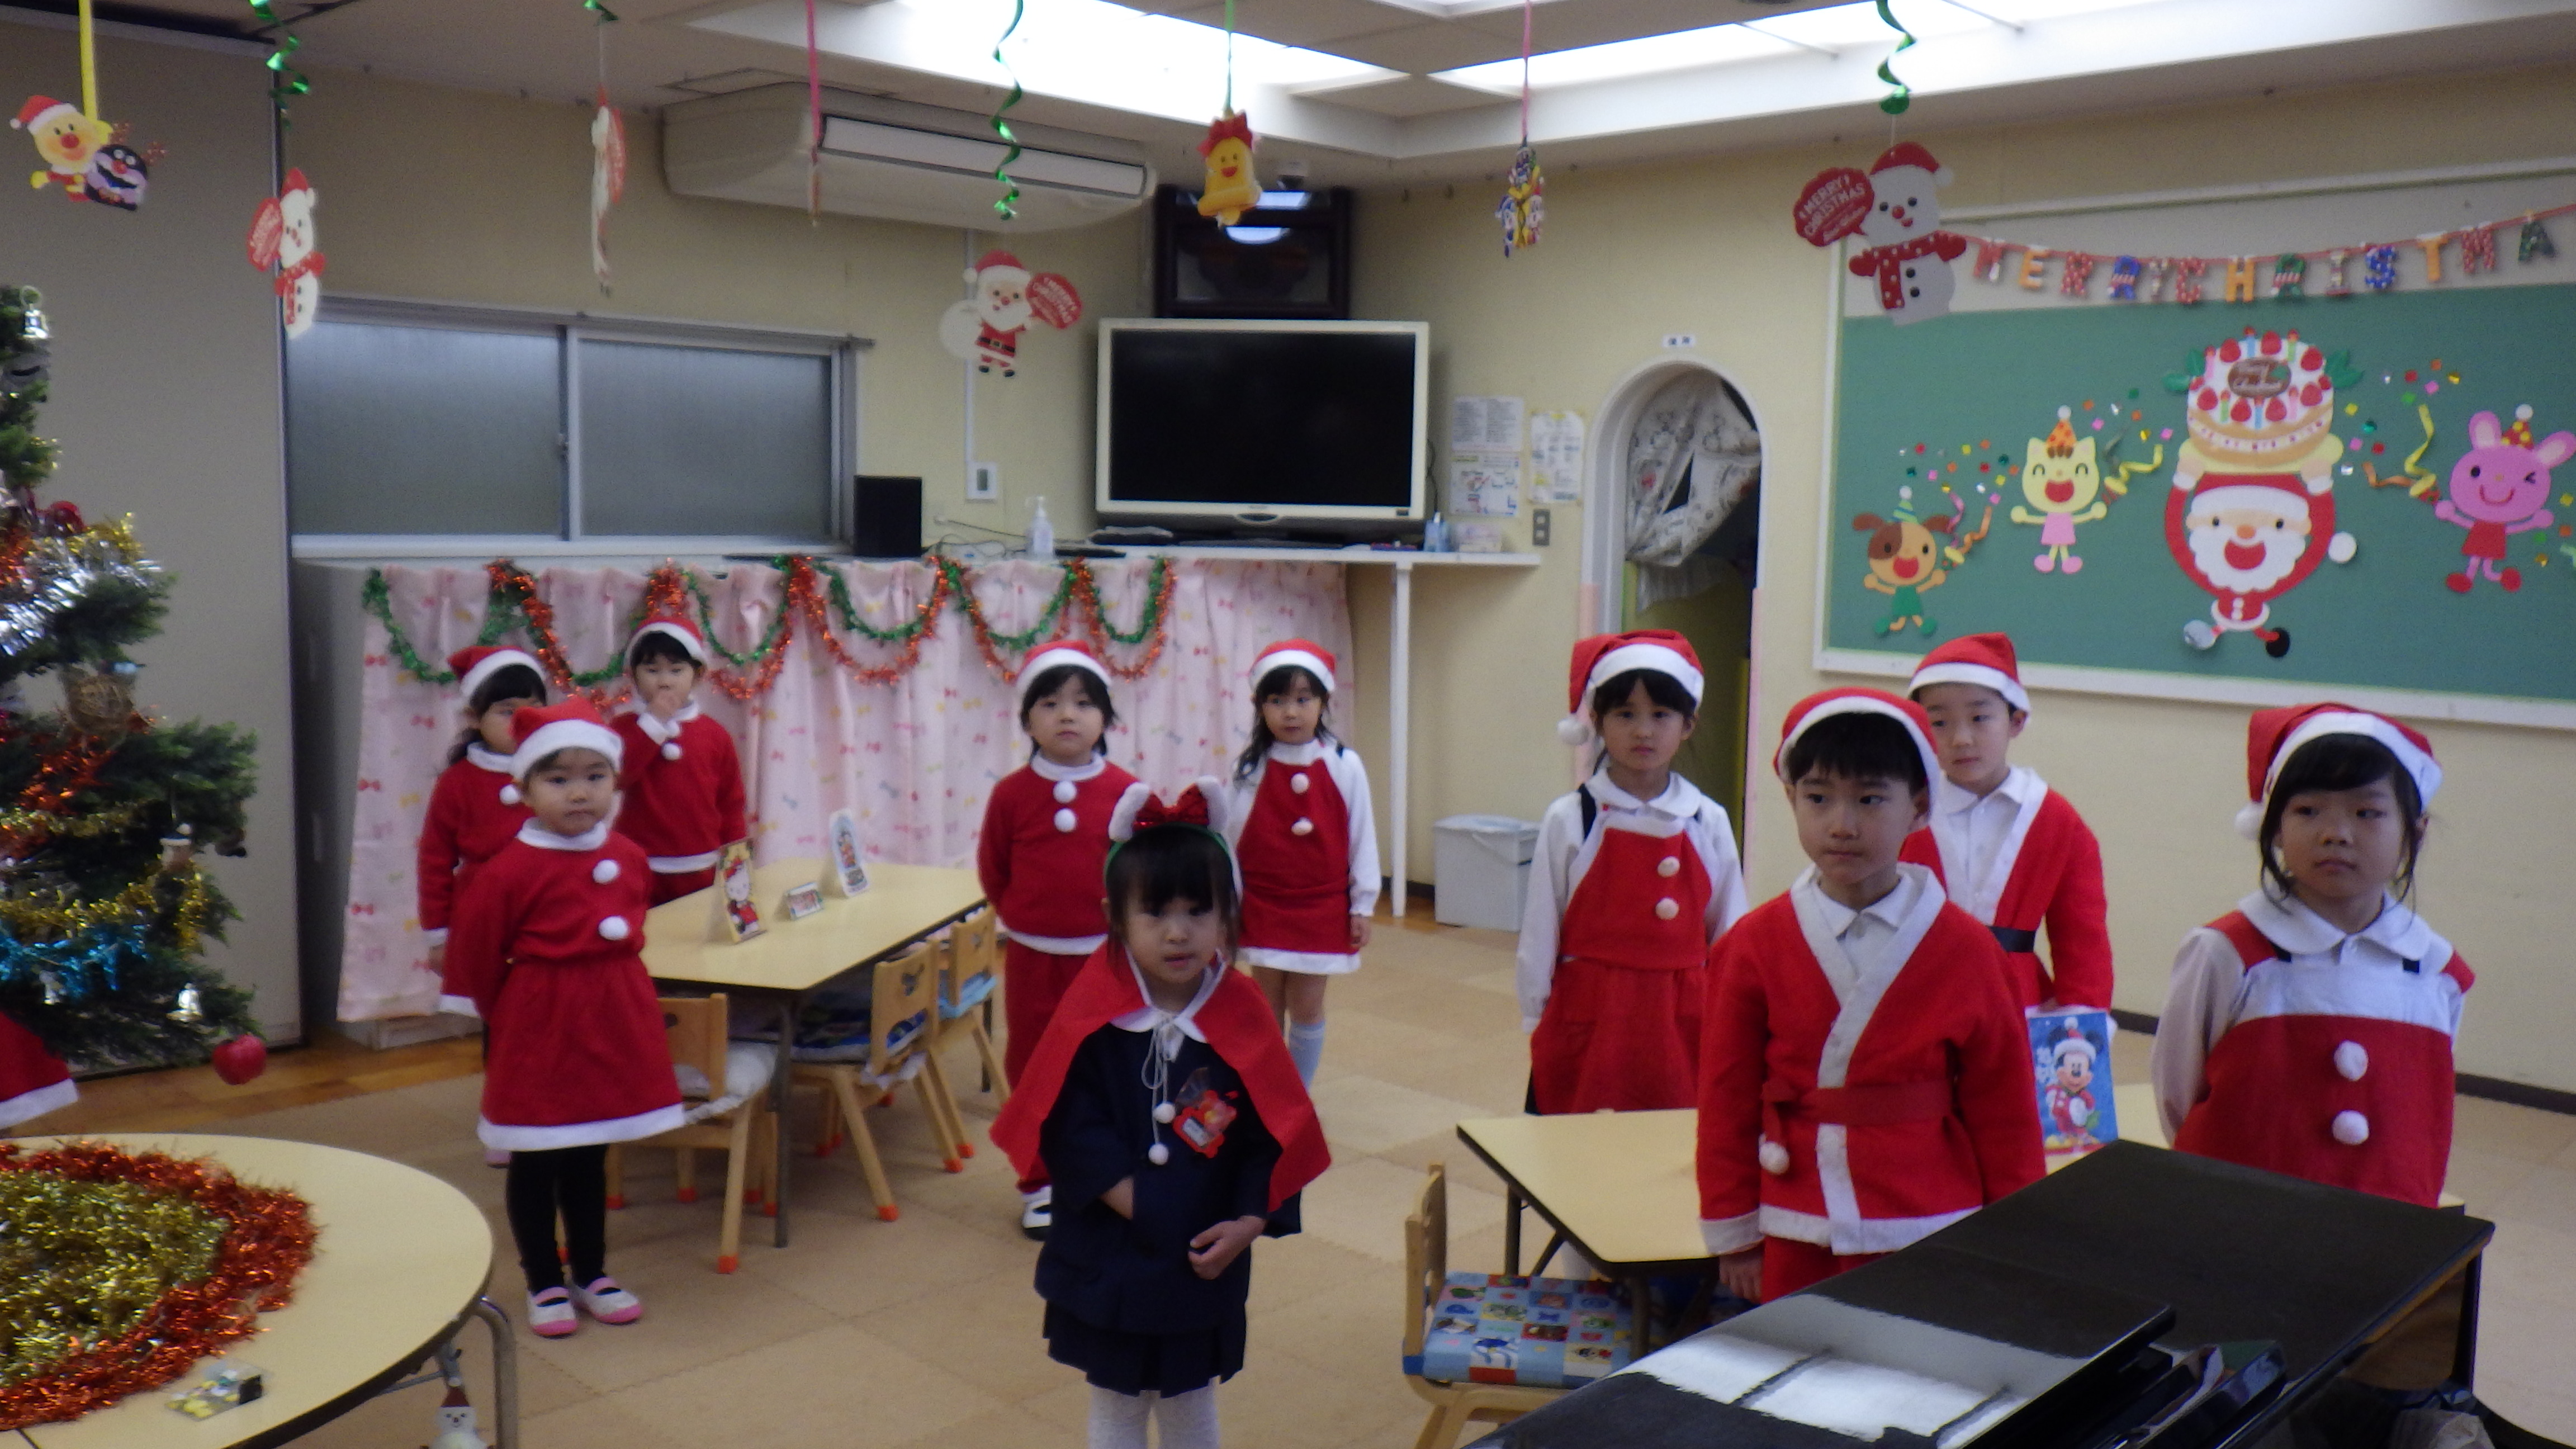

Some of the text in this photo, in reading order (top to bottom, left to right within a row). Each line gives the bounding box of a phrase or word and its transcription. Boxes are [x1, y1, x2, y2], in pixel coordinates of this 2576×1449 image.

[1803, 176, 1843, 214] MERRY
[1804, 183, 1865, 235] CHRISTMAS
[1973, 238, 2170, 302] MERRY
